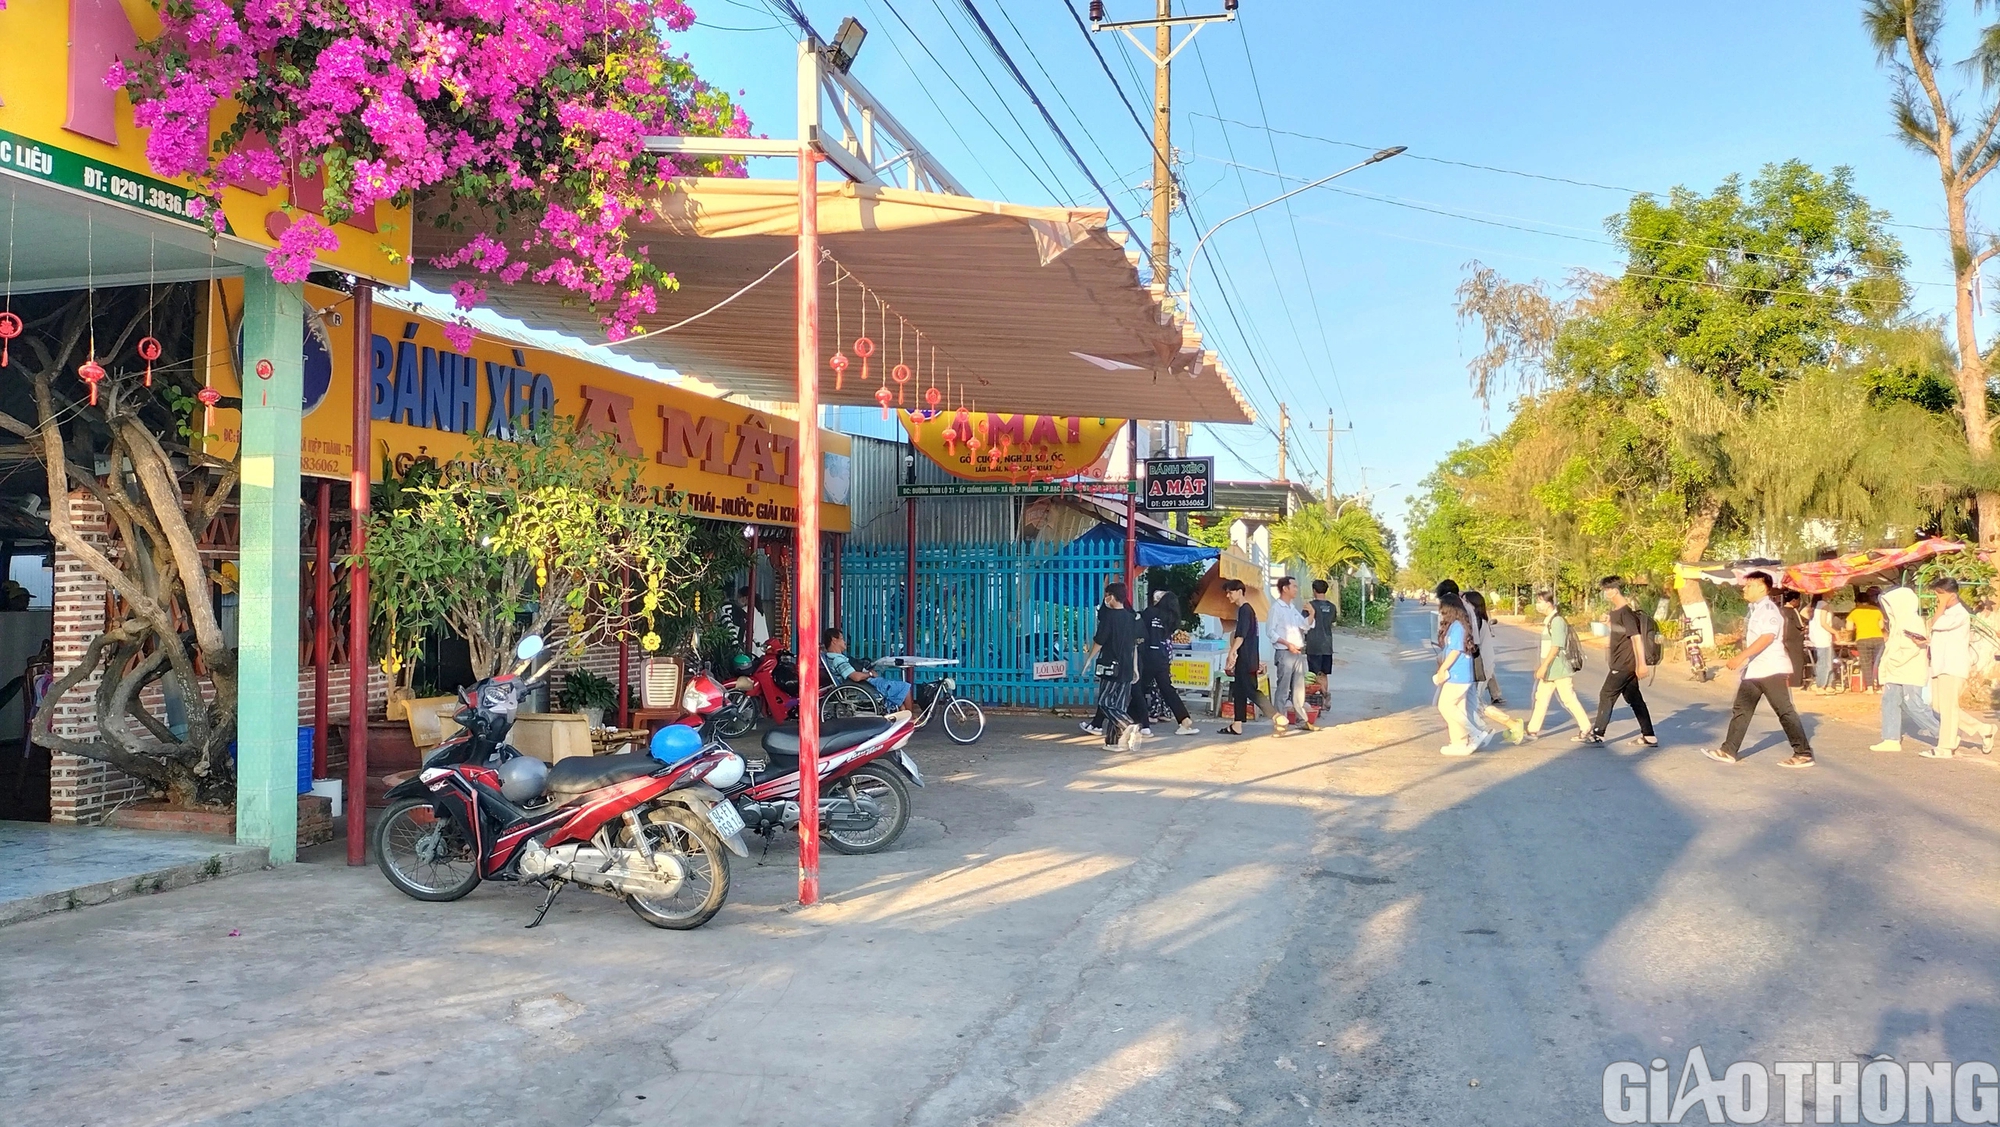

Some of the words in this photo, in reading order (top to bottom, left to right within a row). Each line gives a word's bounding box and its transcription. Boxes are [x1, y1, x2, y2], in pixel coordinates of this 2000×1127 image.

[16, 146, 52, 175] LIÊU
[84, 166, 108, 193] ĐT:
[371, 322, 477, 434] BÁNH
[483, 349, 555, 447] XÈO
[575, 385, 643, 459] A
[1149, 462, 1179, 475] BÁNH
[1181, 461, 1206, 474] XÈO
[1149, 480, 1164, 496] A
[1166, 475, 1207, 498] MẬT
[756, 499, 778, 520] GIẢI
[1178, 499, 1205, 507] 3836062
[1036, 663, 1049, 674] LỐI
[1051, 662, 1065, 673] VÀO
